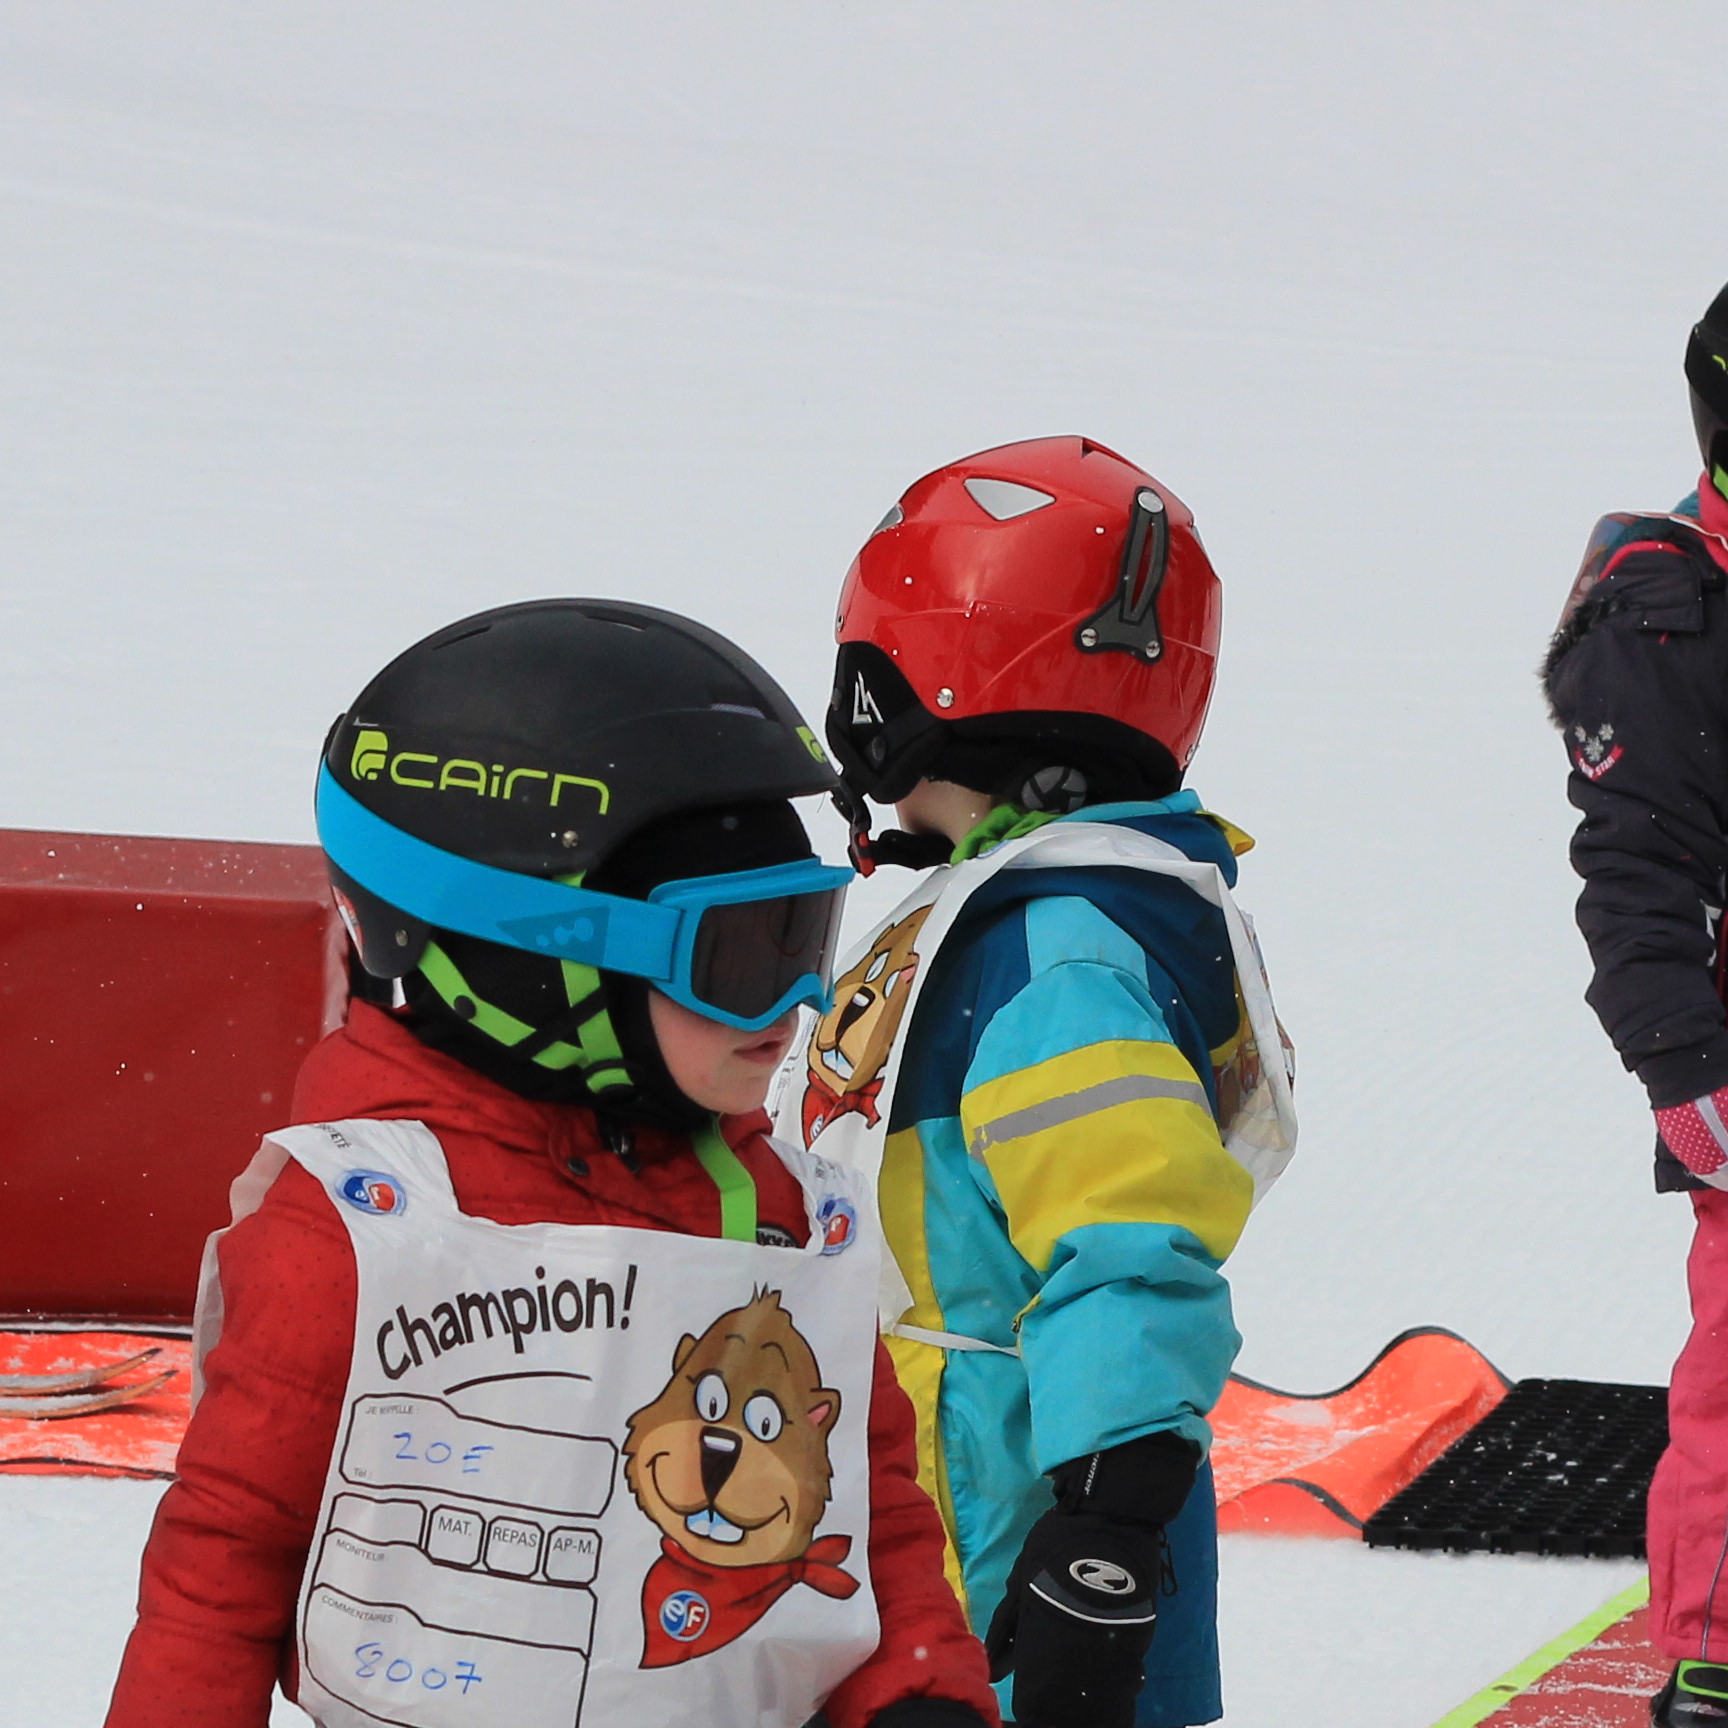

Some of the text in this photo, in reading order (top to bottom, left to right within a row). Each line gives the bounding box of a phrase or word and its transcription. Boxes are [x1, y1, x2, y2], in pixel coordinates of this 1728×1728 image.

[376, 1263, 638, 1380] Champion!
[335, 1538, 385, 1562] MONITEUR
[438, 1516, 595, 1555] MAT. REPAS AP-M.
[321, 1594, 393, 1624] COMMENTAIRES
[354, 1642, 482, 1694] 8007
